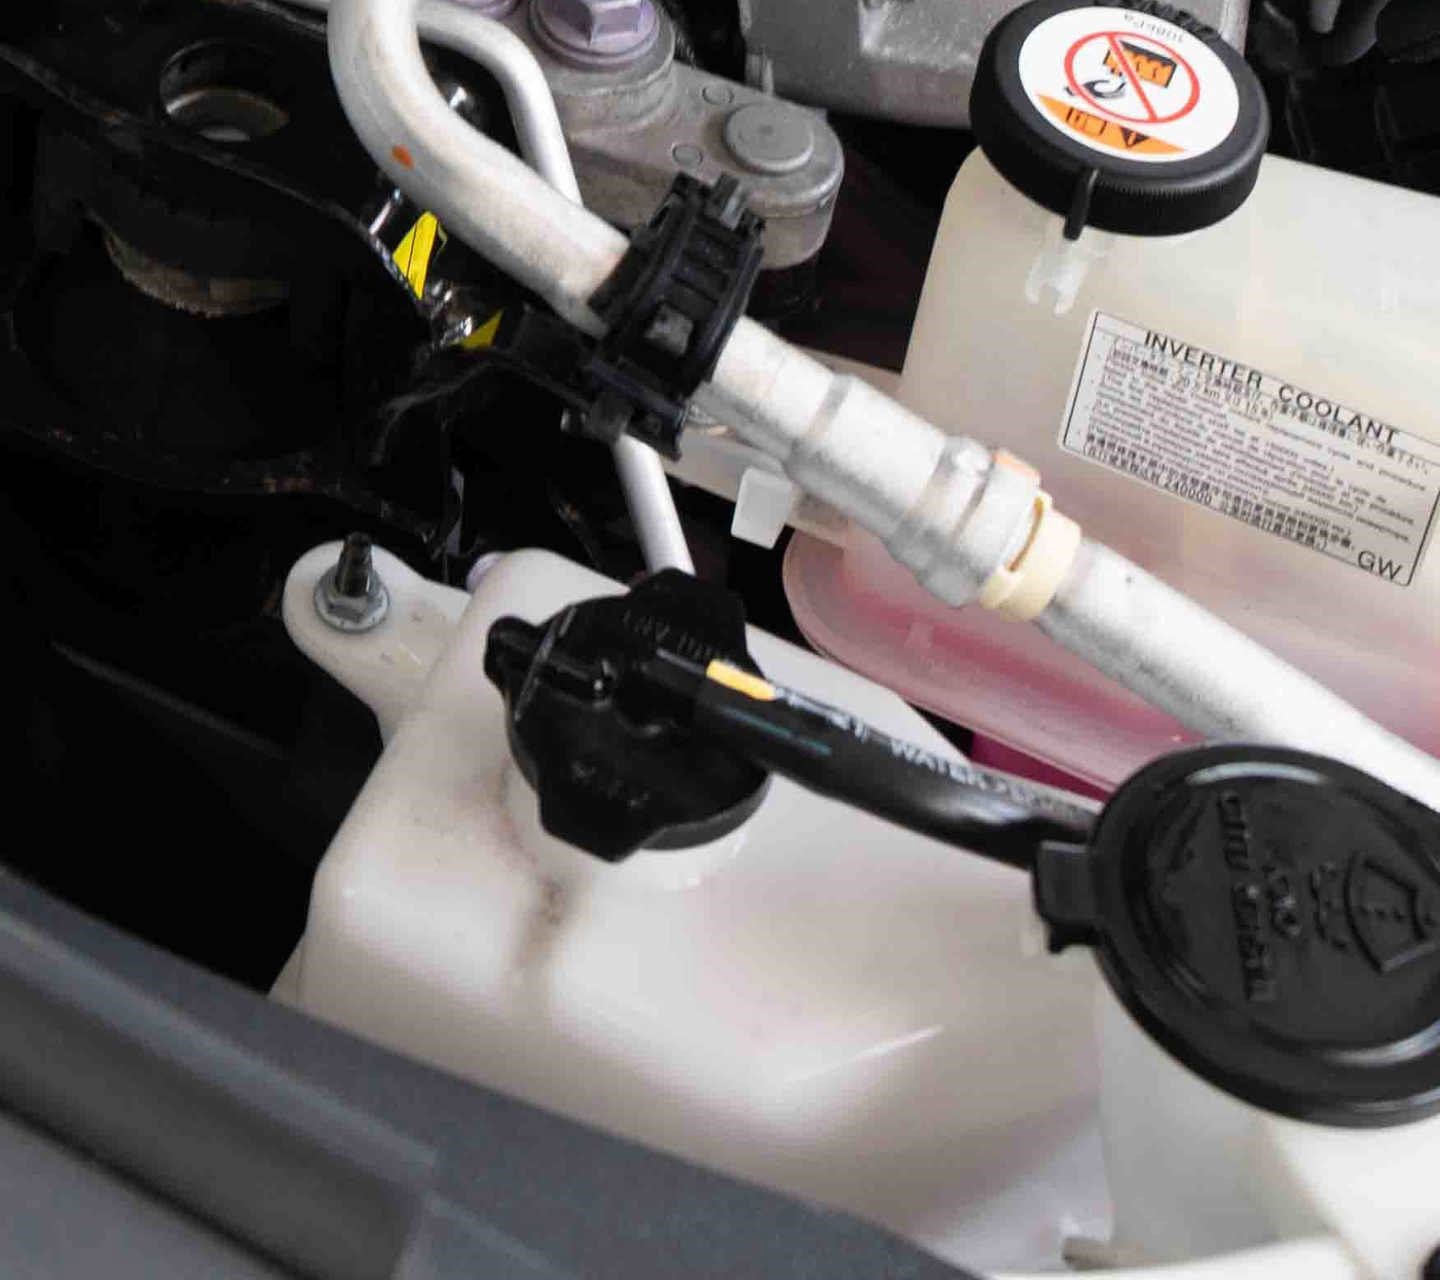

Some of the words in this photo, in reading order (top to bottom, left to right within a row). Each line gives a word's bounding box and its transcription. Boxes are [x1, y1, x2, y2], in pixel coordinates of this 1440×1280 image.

[1144, 329, 1263, 391] INVERTER
[1278, 384, 1401, 446] COOLANT
[1357, 549, 1403, 581] GW
